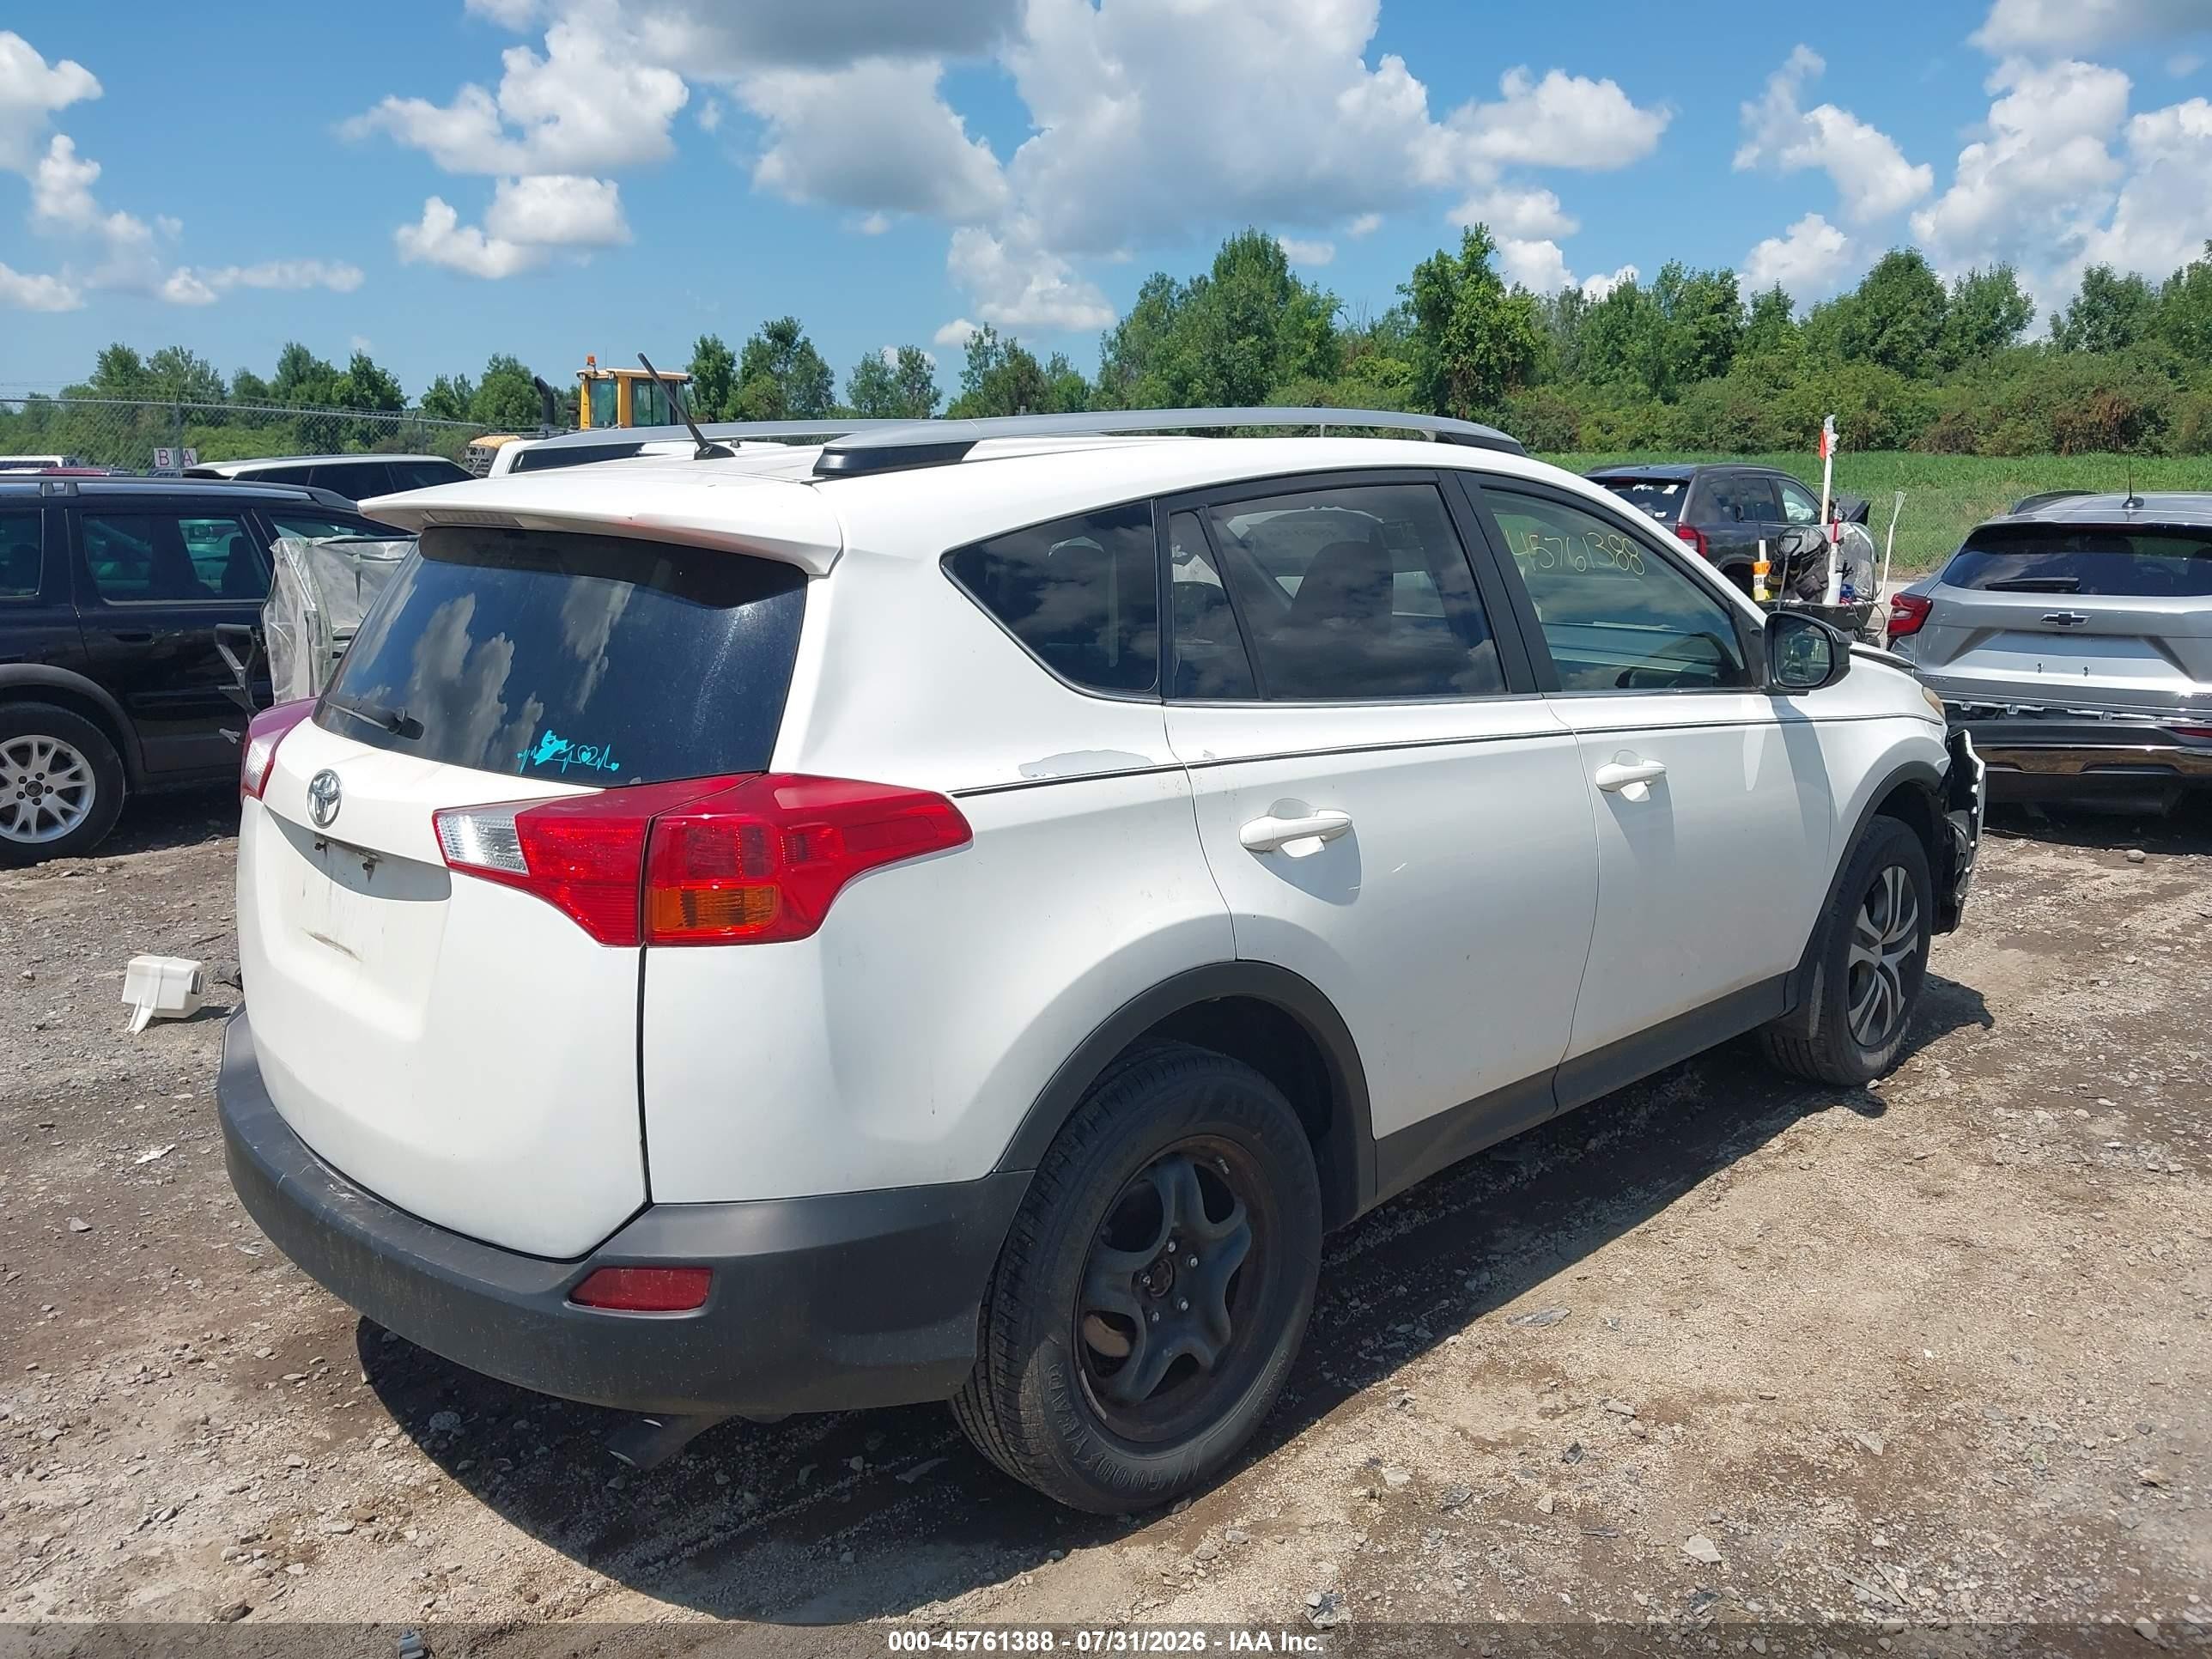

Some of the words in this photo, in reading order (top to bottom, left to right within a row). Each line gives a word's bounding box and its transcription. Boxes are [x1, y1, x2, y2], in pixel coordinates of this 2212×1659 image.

[158, 449, 170, 466] B
[183, 449, 194, 467] A
[1505, 529, 1645, 576] 45761388
